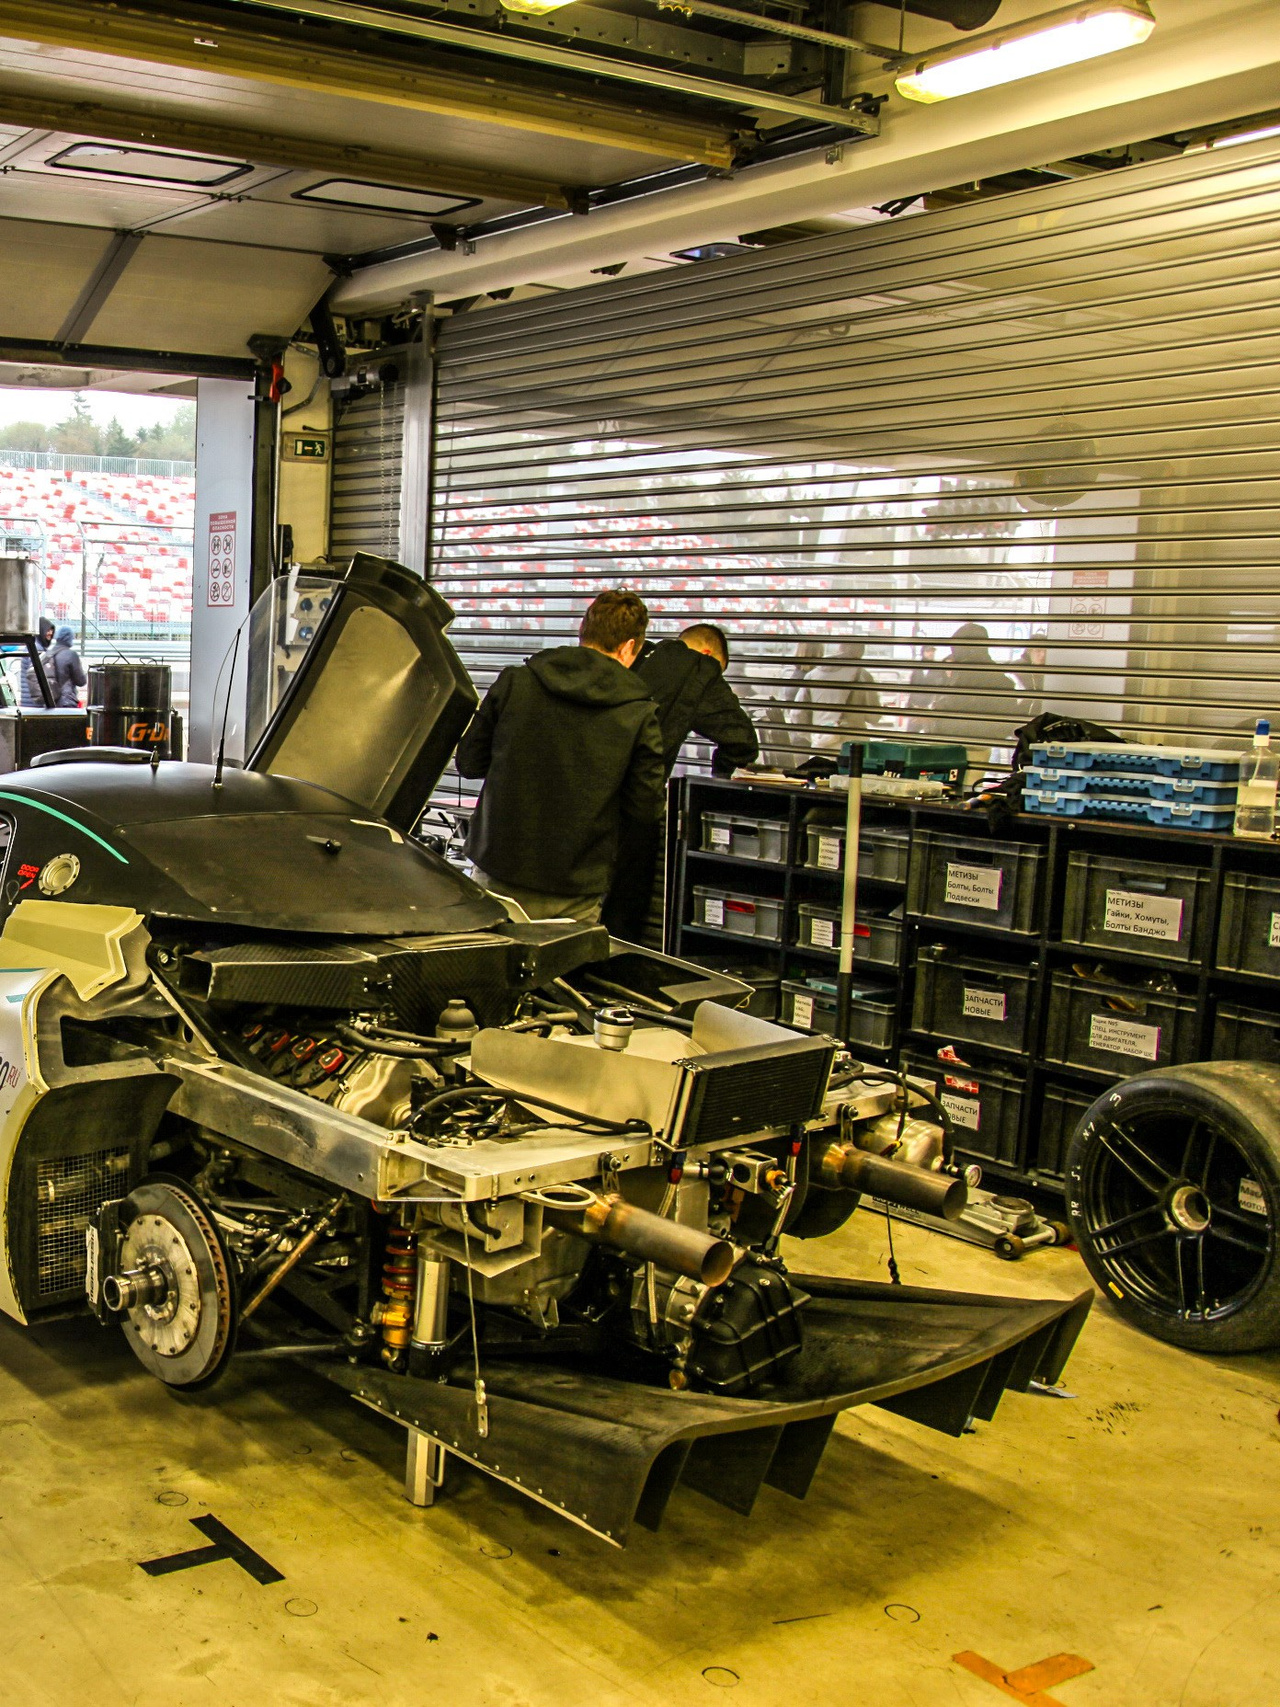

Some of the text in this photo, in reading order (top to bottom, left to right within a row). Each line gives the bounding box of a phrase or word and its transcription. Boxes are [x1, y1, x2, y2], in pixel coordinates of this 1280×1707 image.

[948, 870, 979, 880] МЕТИЗЫ
[947, 881, 994, 894] Болты, Болты
[946, 891, 980, 903] Подвески
[1107, 897, 1144, 909] МЕТИЗЫ
[1107, 908, 1169, 925] Гайки, Хомуты,
[1105, 921, 1166, 936] Болты Банджо
[965, 994, 1003, 1006] ЗАПЧАСТИ
[964, 1006, 991, 1016] НОВЫЕ
[1108, 1028, 1146, 1040] ИНСТРУМЕНТ
[941, 1100, 978, 1115] ЗАПЧАСТИ
